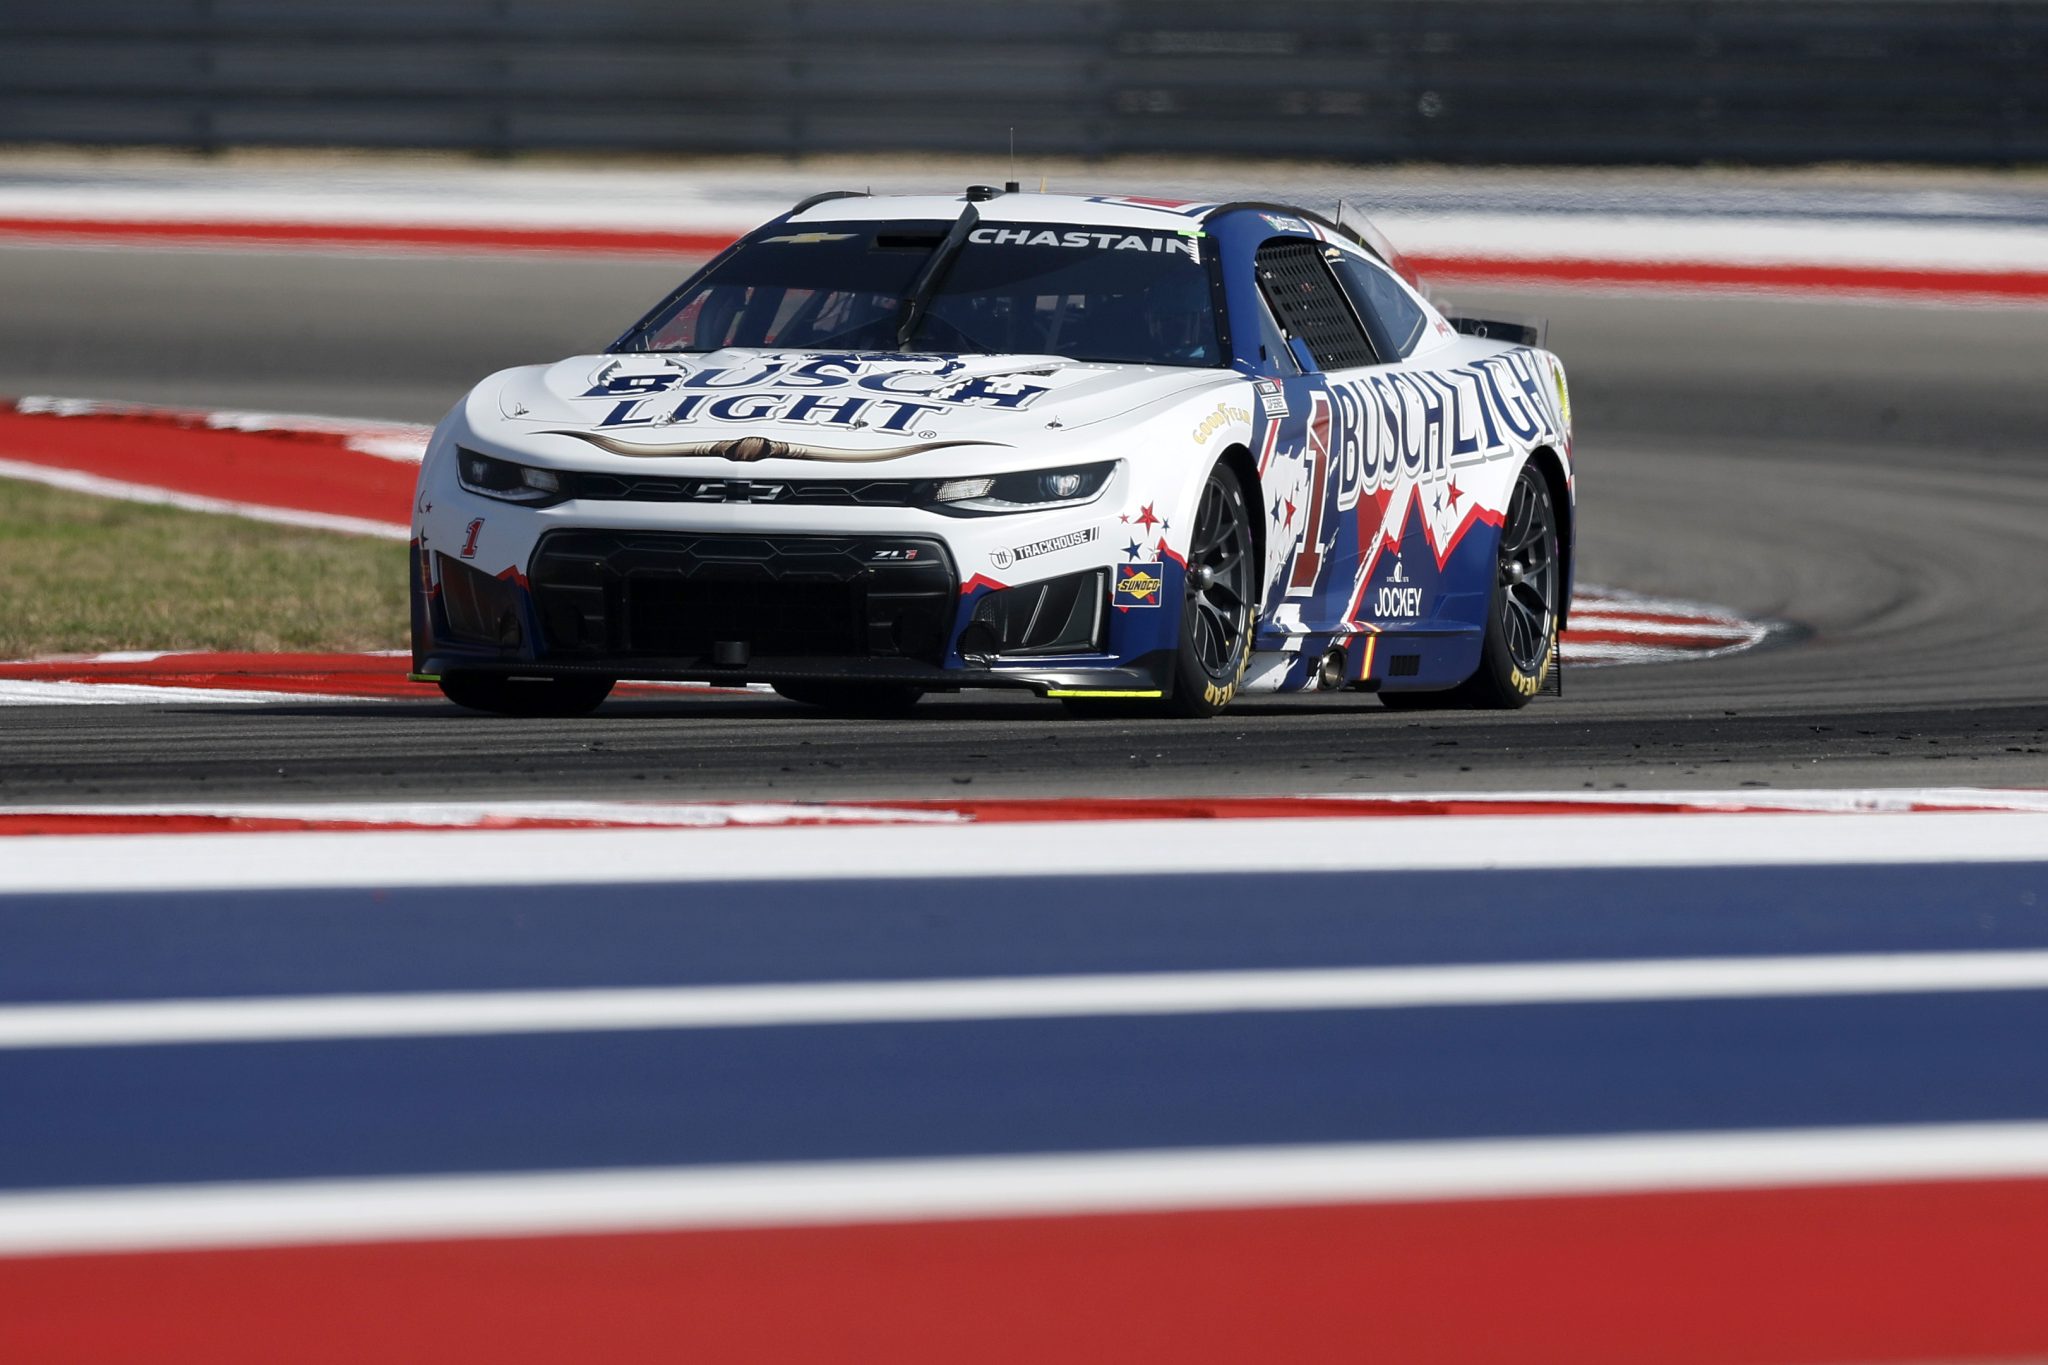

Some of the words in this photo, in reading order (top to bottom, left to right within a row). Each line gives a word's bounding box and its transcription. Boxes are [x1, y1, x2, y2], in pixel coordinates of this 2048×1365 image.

[968, 228, 1194, 254] CHASTAIN
[578, 354, 1051, 408] BUSCH
[595, 393, 944, 433] LIGHT
[1192, 402, 1251, 445] GOODYEAR
[1424, 347, 1557, 460] LIGH
[1285, 390, 1333, 598] 1
[460, 517, 485, 559] 1
[872, 549, 918, 560] ZL1
[1016, 530, 1089, 559] TRACKHOUSE
[1119, 580, 1159, 591] SUNOCO
[1374, 587, 1422, 617] JOCKEY
